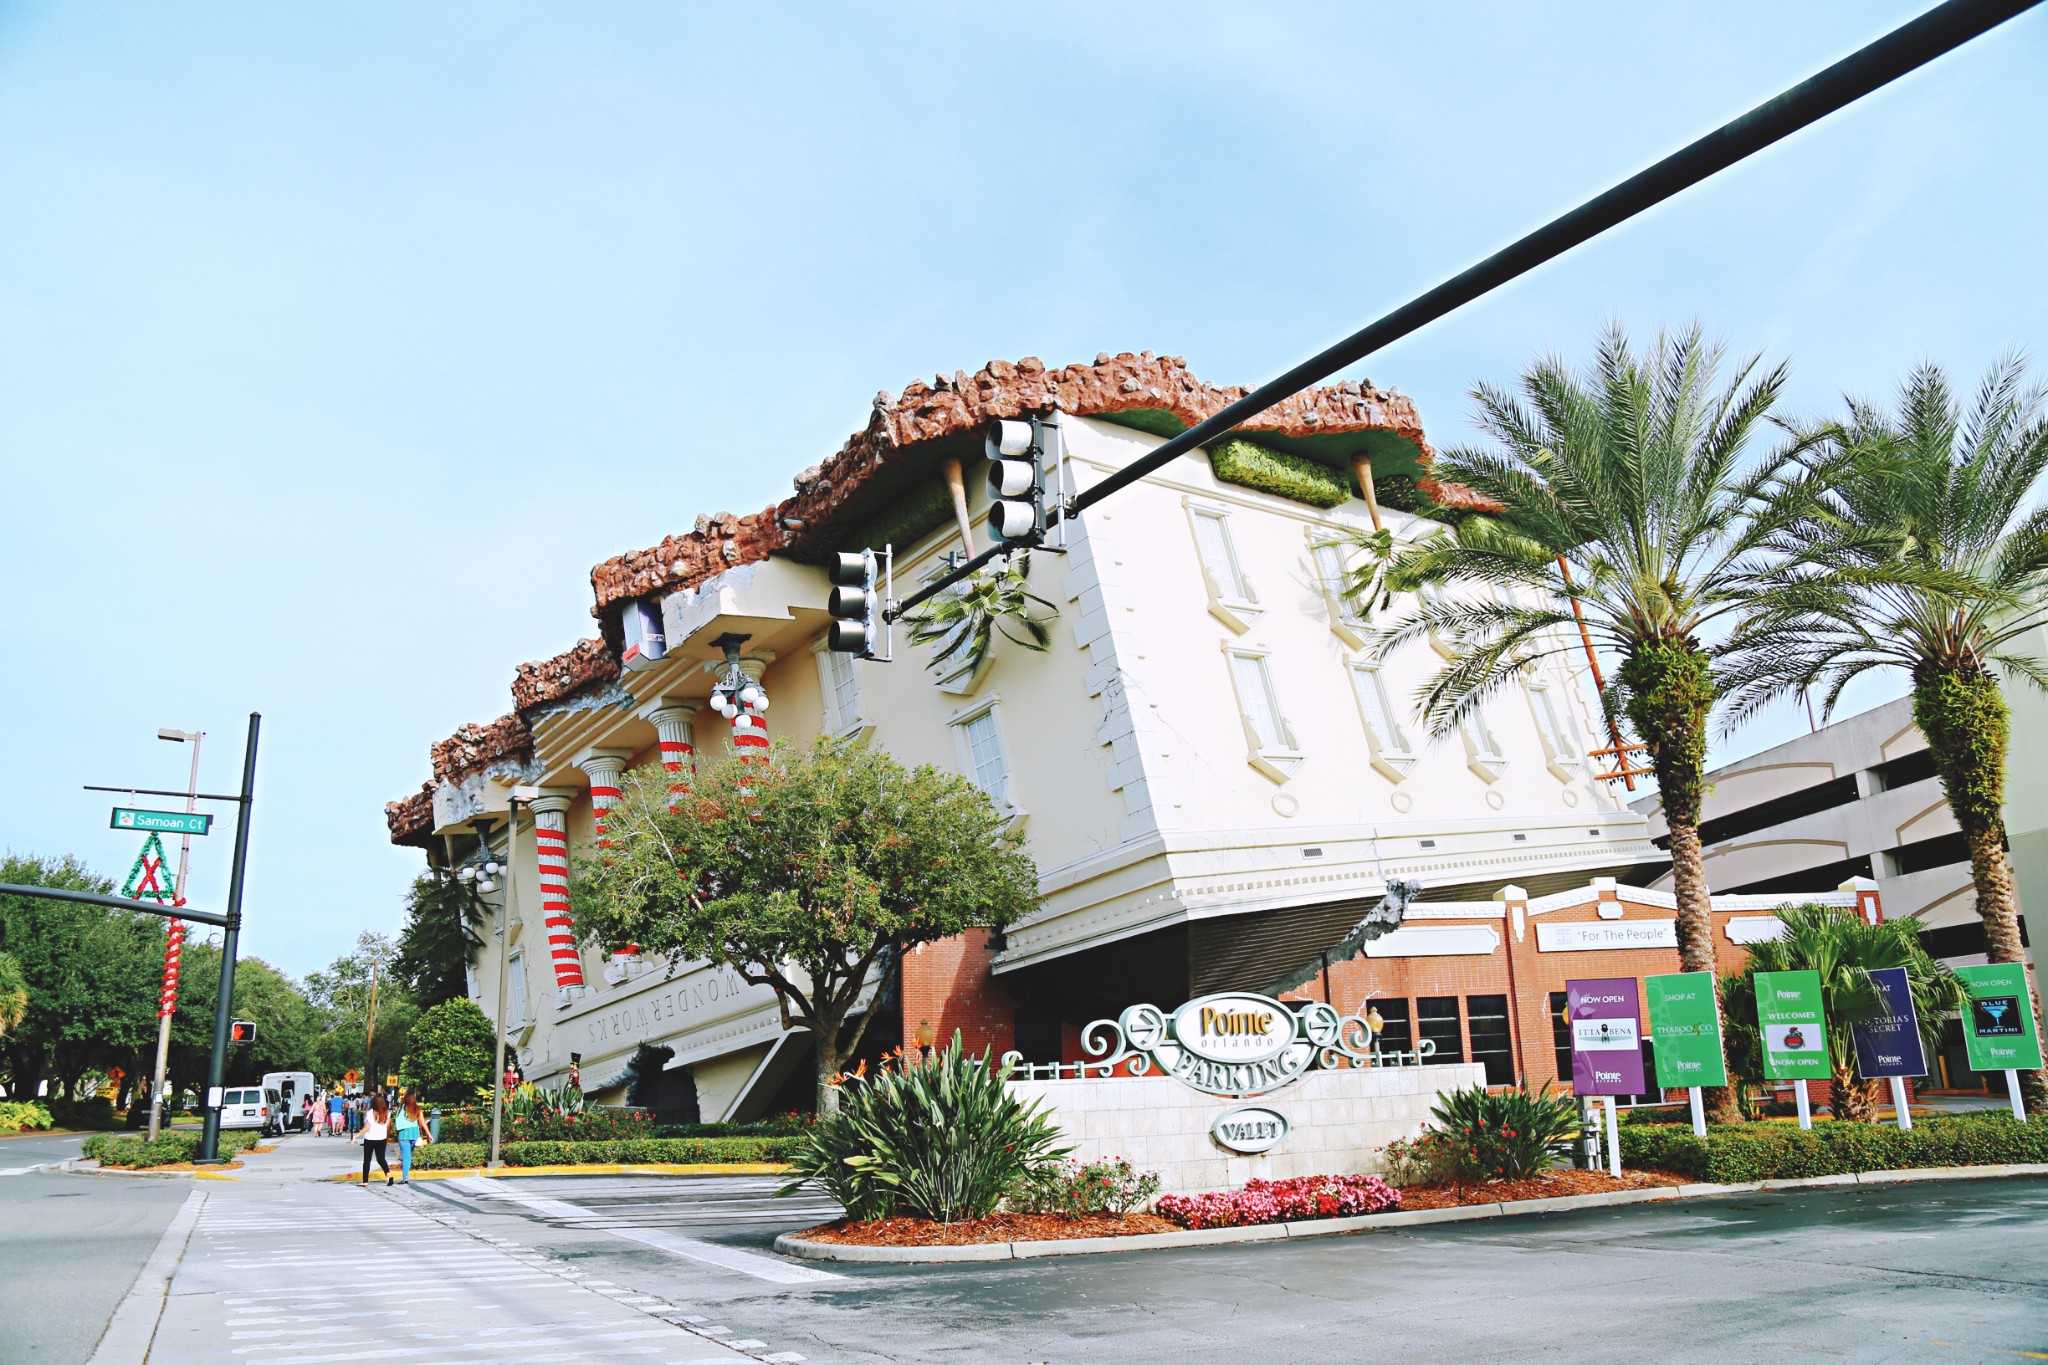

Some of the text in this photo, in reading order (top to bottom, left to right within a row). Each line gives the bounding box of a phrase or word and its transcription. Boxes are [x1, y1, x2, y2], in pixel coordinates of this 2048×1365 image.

[137, 815, 203, 829] Samoan Ct
[1603, 930, 1624, 940] The
[1971, 979, 2012, 988] NOW OPEN
[1580, 995, 1625, 1004] NOW OPEN
[1768, 1011, 1816, 1020] WELCOMES
[1858, 1014, 1909, 1026] TORIA'S
[1200, 1007, 1275, 1036] Pointe
[1869, 1024, 1902, 1033] SECRET
[1201, 1037, 1274, 1048] orlando
[1878, 1055, 1902, 1063] Pointe
[1173, 1048, 1299, 1090] PARKING
[1677, 1061, 1702, 1070] Pointe
[1595, 1071, 1621, 1080] Pointe
[1221, 1121, 1280, 1141] VALET
